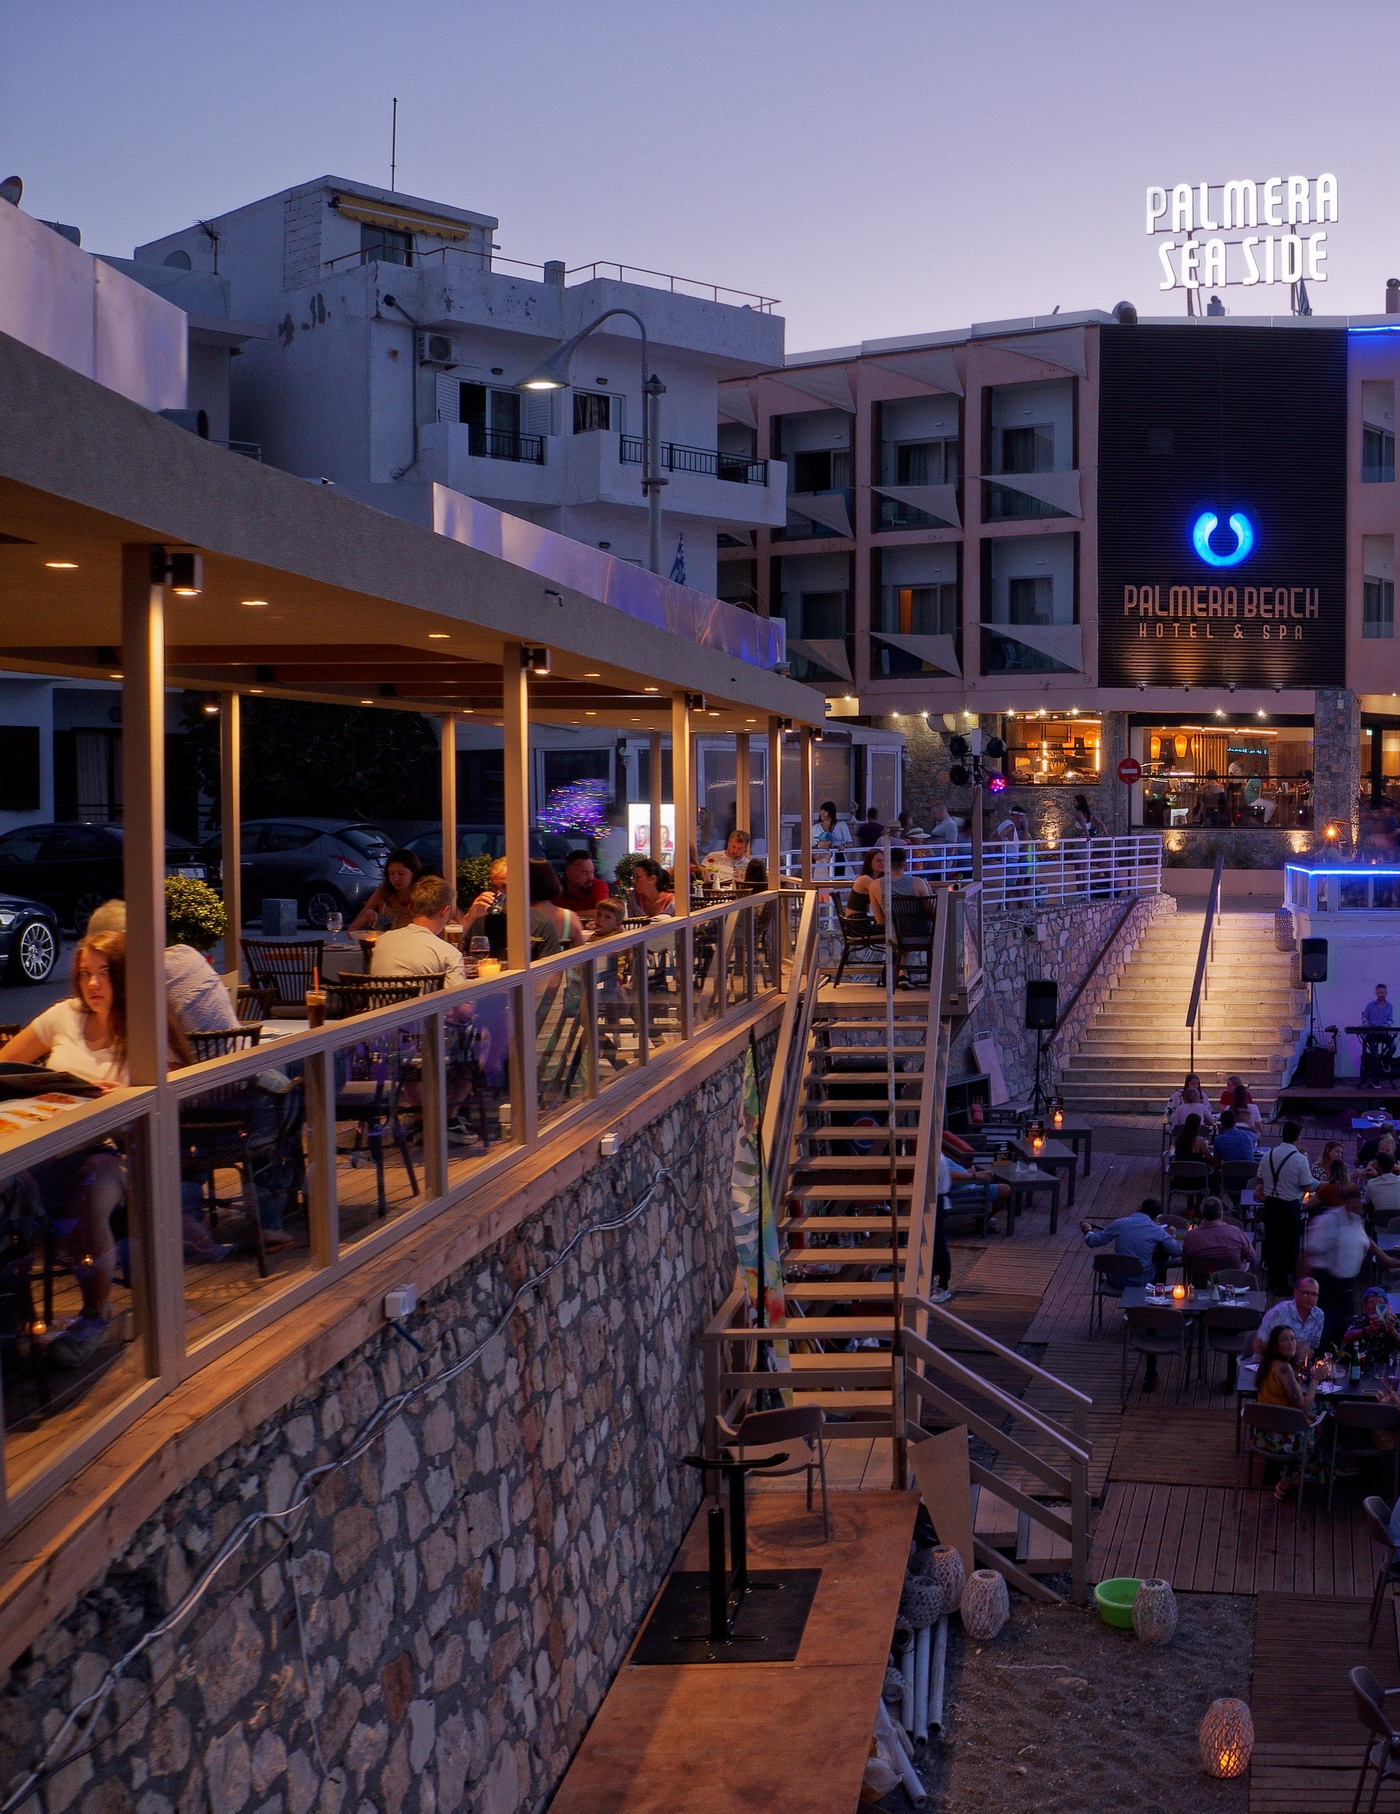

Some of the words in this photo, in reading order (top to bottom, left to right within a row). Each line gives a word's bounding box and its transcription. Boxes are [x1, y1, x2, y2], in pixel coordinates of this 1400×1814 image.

[1146, 173, 1338, 235] PALMERA
[1158, 237, 1226, 290] SEA
[1242, 232, 1327, 285] SIDE
[1124, 585, 1238, 617] PALMERA
[1244, 587, 1319, 619] BEACH
[1139, 622, 1214, 639] HOTEL
[1233, 624, 1244, 639] &
[1262, 625, 1303, 640] SPA
